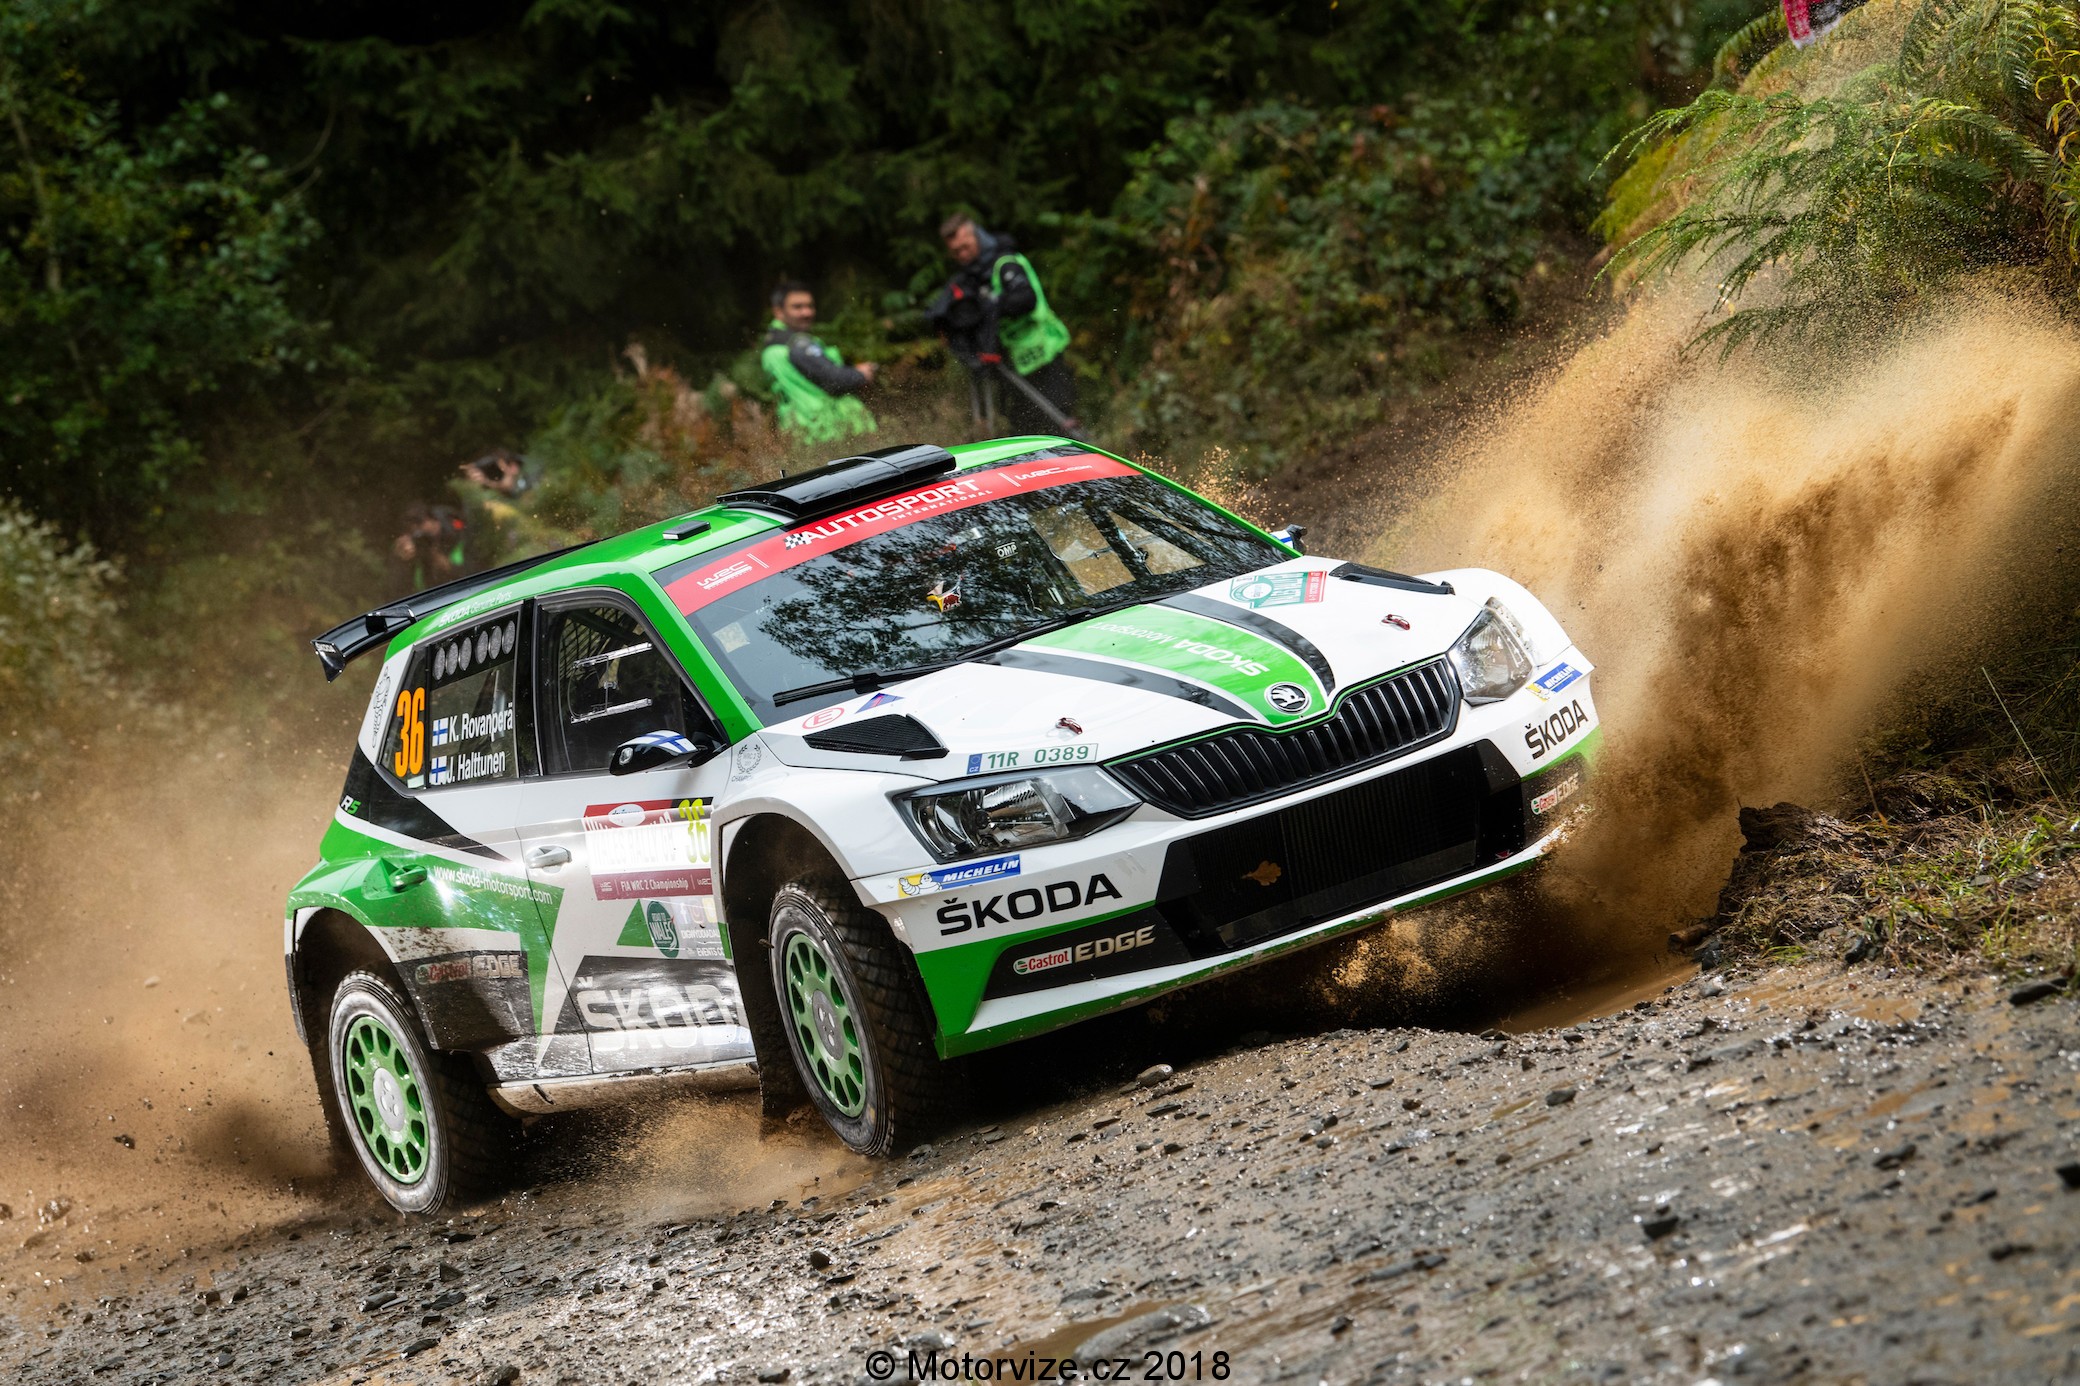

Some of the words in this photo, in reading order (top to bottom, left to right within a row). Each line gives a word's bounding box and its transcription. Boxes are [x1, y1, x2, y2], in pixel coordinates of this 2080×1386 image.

[805, 479, 980, 545] AUTOSPORT
[892, 490, 993, 521] INTERNATIONAL
[996, 544, 1017, 558] OMP
[696, 561, 749, 587] WRC
[1085, 622, 1178, 644] Motorsport
[1545, 664, 1575, 689] MICHELIN
[449, 716, 459, 742] K.
[461, 702, 513, 742] Rovanperä
[813, 709, 833, 726] E
[1524, 699, 1589, 760] ŠKODA
[395, 687, 425, 777] 36
[446, 761, 455, 784] J.
[458, 751, 506, 782] Halttunen
[969, 766, 979, 774] CZ
[987, 751, 1019, 769] 11R
[1034, 745, 1089, 764] 0389
[340, 795, 361, 815] R5
[678, 799, 711, 863] 36
[942, 859, 1020, 883] MICHELIN
[434, 866, 553, 905] www.skoda-motorsport.com
[620, 881, 631, 892] FIA
[631, 880, 643, 891] WRC
[644, 880, 650, 890] 2
[650, 877, 689, 892] Championship
[936, 873, 1122, 936] ŠKODA
[649, 920, 678, 946] WALES
[1029, 951, 1070, 971] Castrol
[1075, 924, 1156, 963] EDGE
